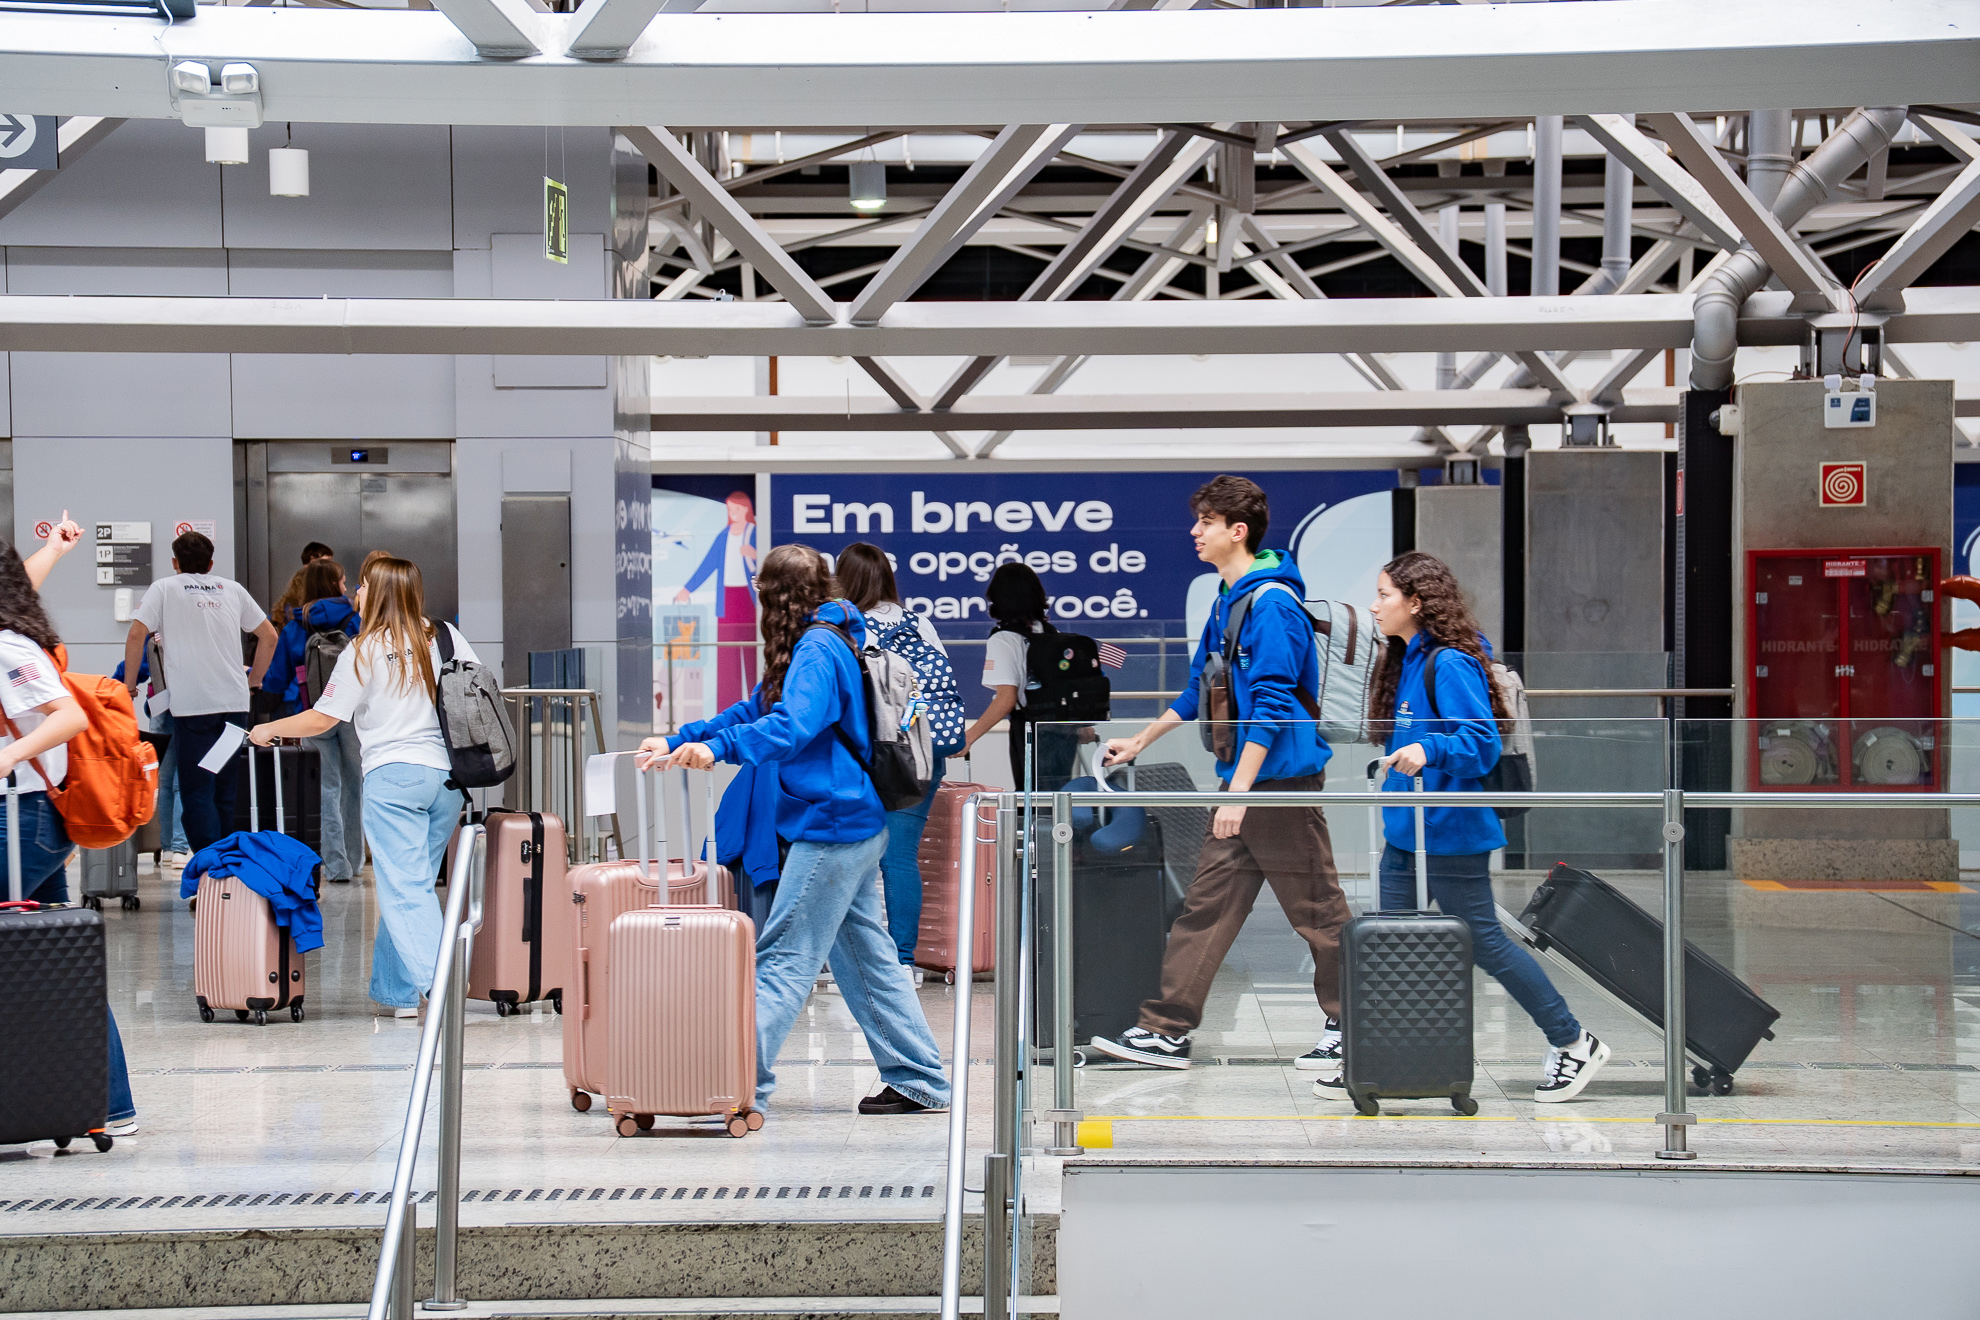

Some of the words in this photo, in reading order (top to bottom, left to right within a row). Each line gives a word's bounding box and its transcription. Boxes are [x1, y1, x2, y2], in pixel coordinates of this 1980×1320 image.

[793, 493, 894, 534] Em
[911, 491, 1114, 533] breve
[97, 528, 111, 537] 2P
[99, 550, 111, 558] 1P
[1089, 542, 1147, 573] de
[102, 571, 108, 579] T
[905, 595, 988, 619] par
[1762, 640, 1835, 652] HIDRANTE
